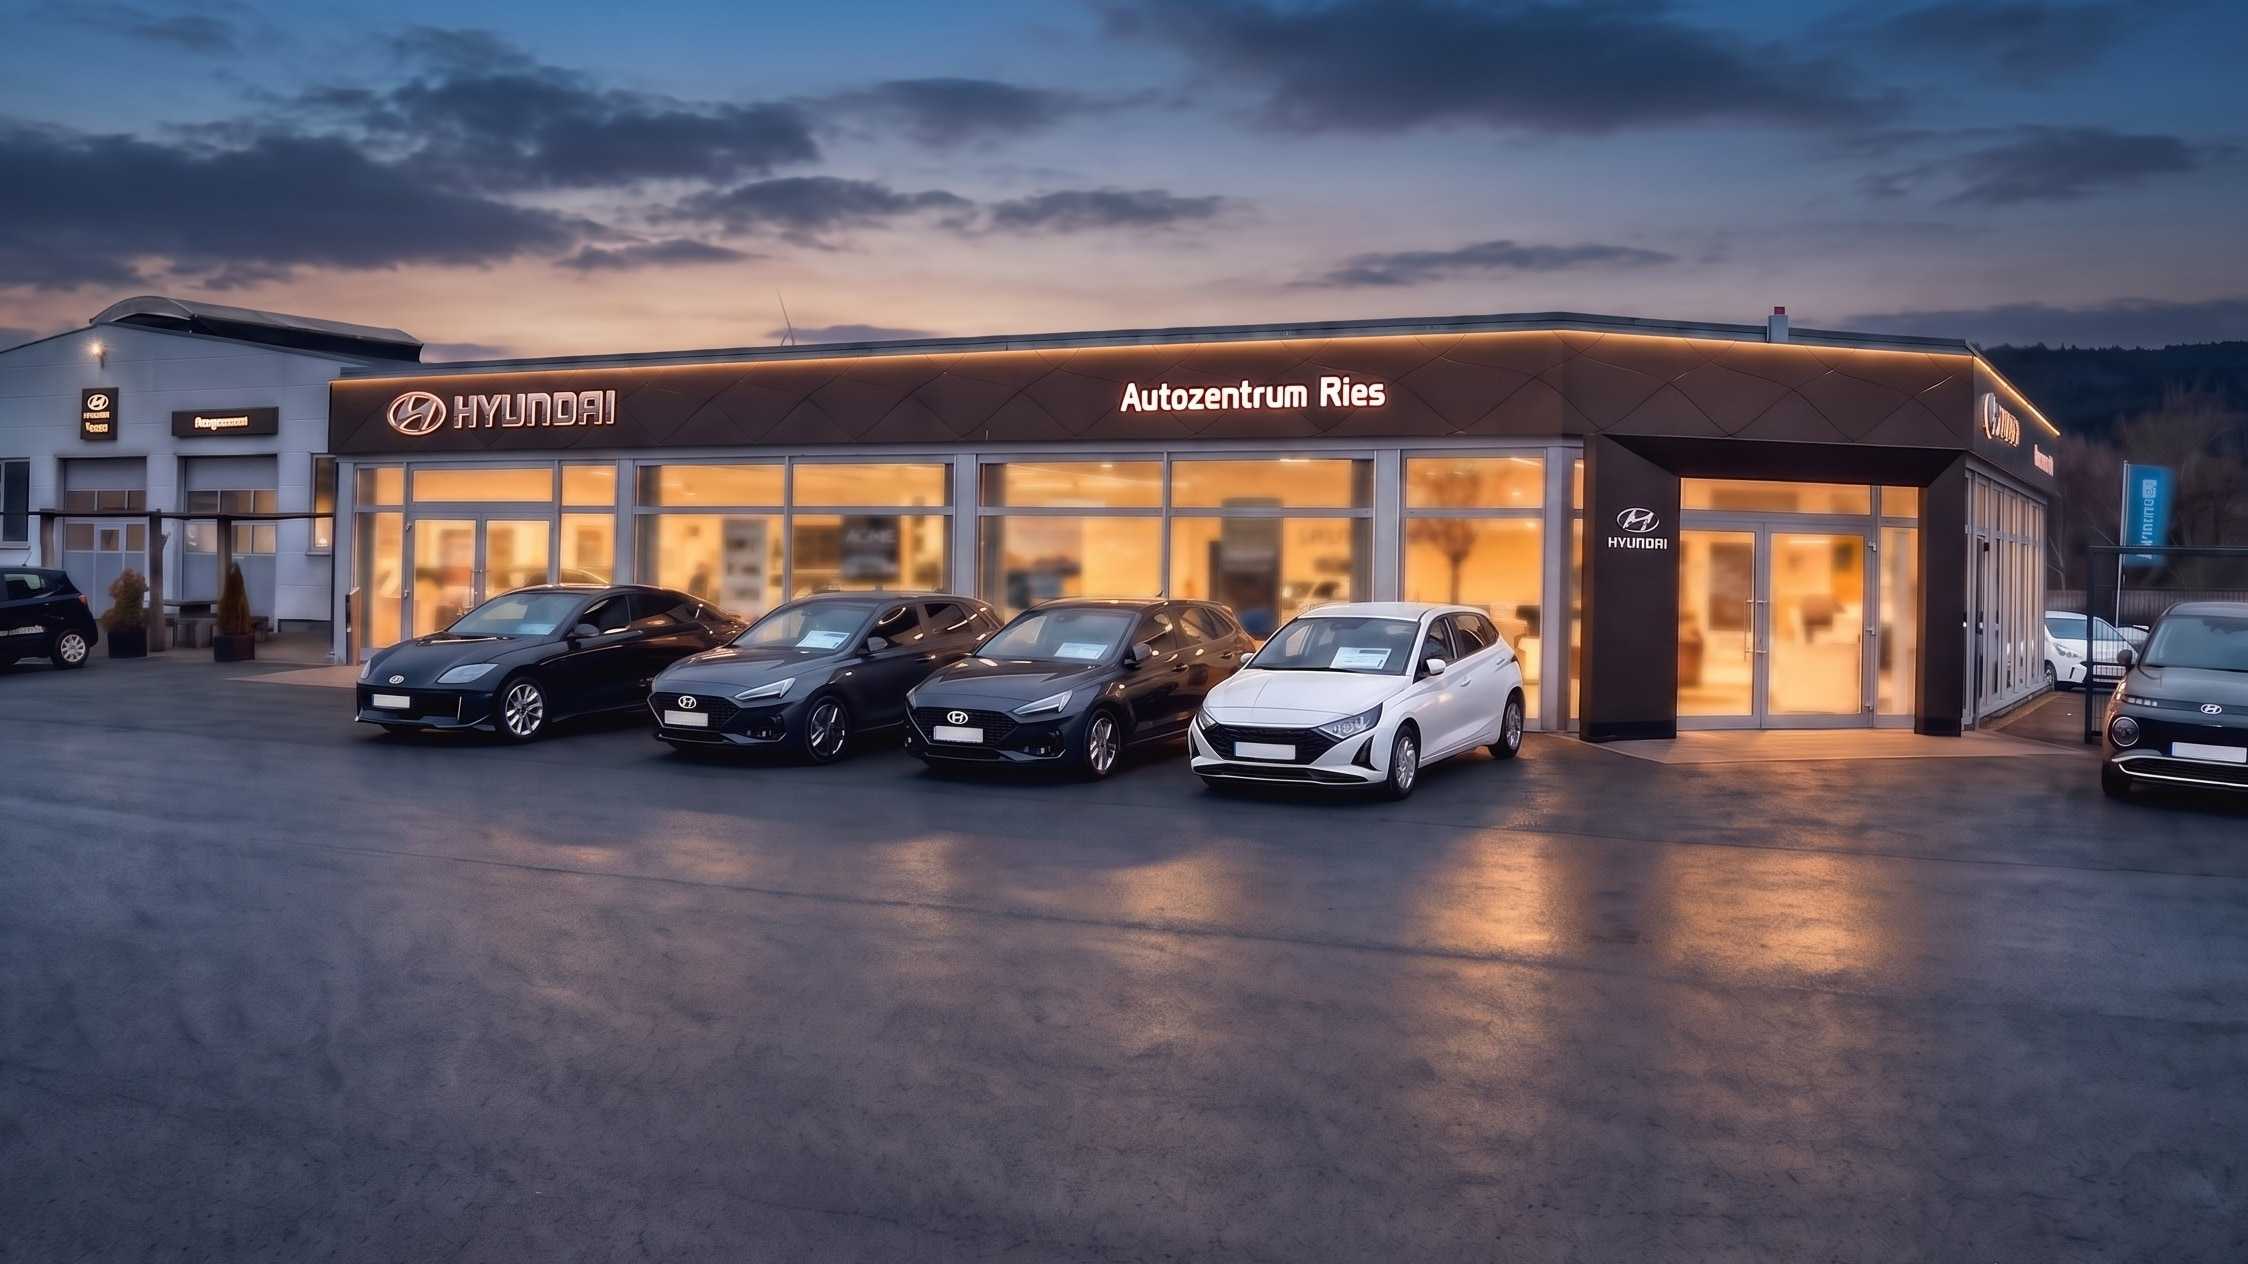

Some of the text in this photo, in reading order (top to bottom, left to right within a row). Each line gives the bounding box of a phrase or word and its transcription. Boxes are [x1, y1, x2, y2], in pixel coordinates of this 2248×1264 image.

[453, 390, 616, 429] HYUNDAI
[1120, 376, 1386, 412] Autozentrum Ries
[1607, 536, 1668, 550] HYUNDAI
